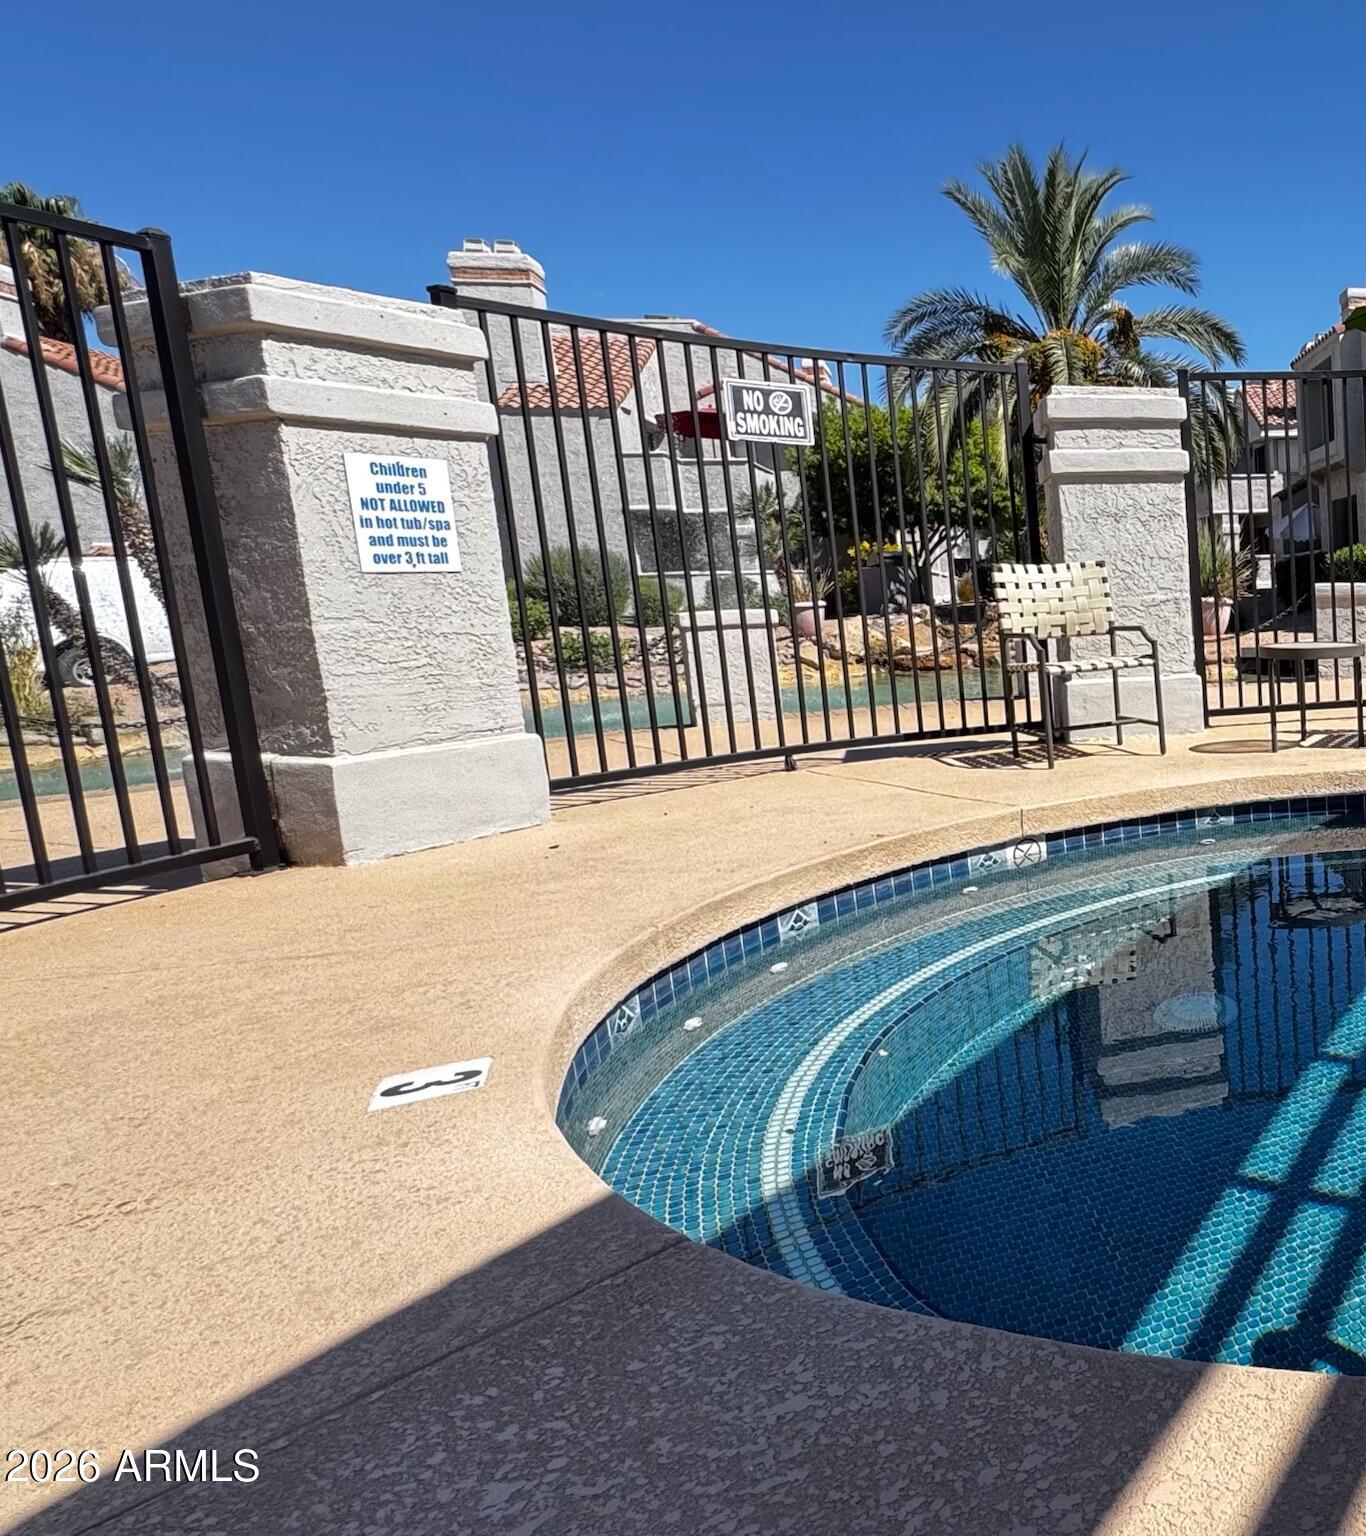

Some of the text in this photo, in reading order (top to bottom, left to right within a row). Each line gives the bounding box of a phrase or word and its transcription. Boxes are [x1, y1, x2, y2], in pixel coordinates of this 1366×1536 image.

[742, 389, 764, 412] NO
[736, 411, 805, 437] SMOKING
[369, 461, 427, 479] Children
[376, 482, 427, 495] under 5
[360, 497, 445, 513] NOT ALLOWED
[359, 515, 451, 532] in hot tub/spa
[368, 534, 448, 548] and must be
[373, 551, 449, 565] over 3 ft tall
[380, 1070, 483, 1097] 3
